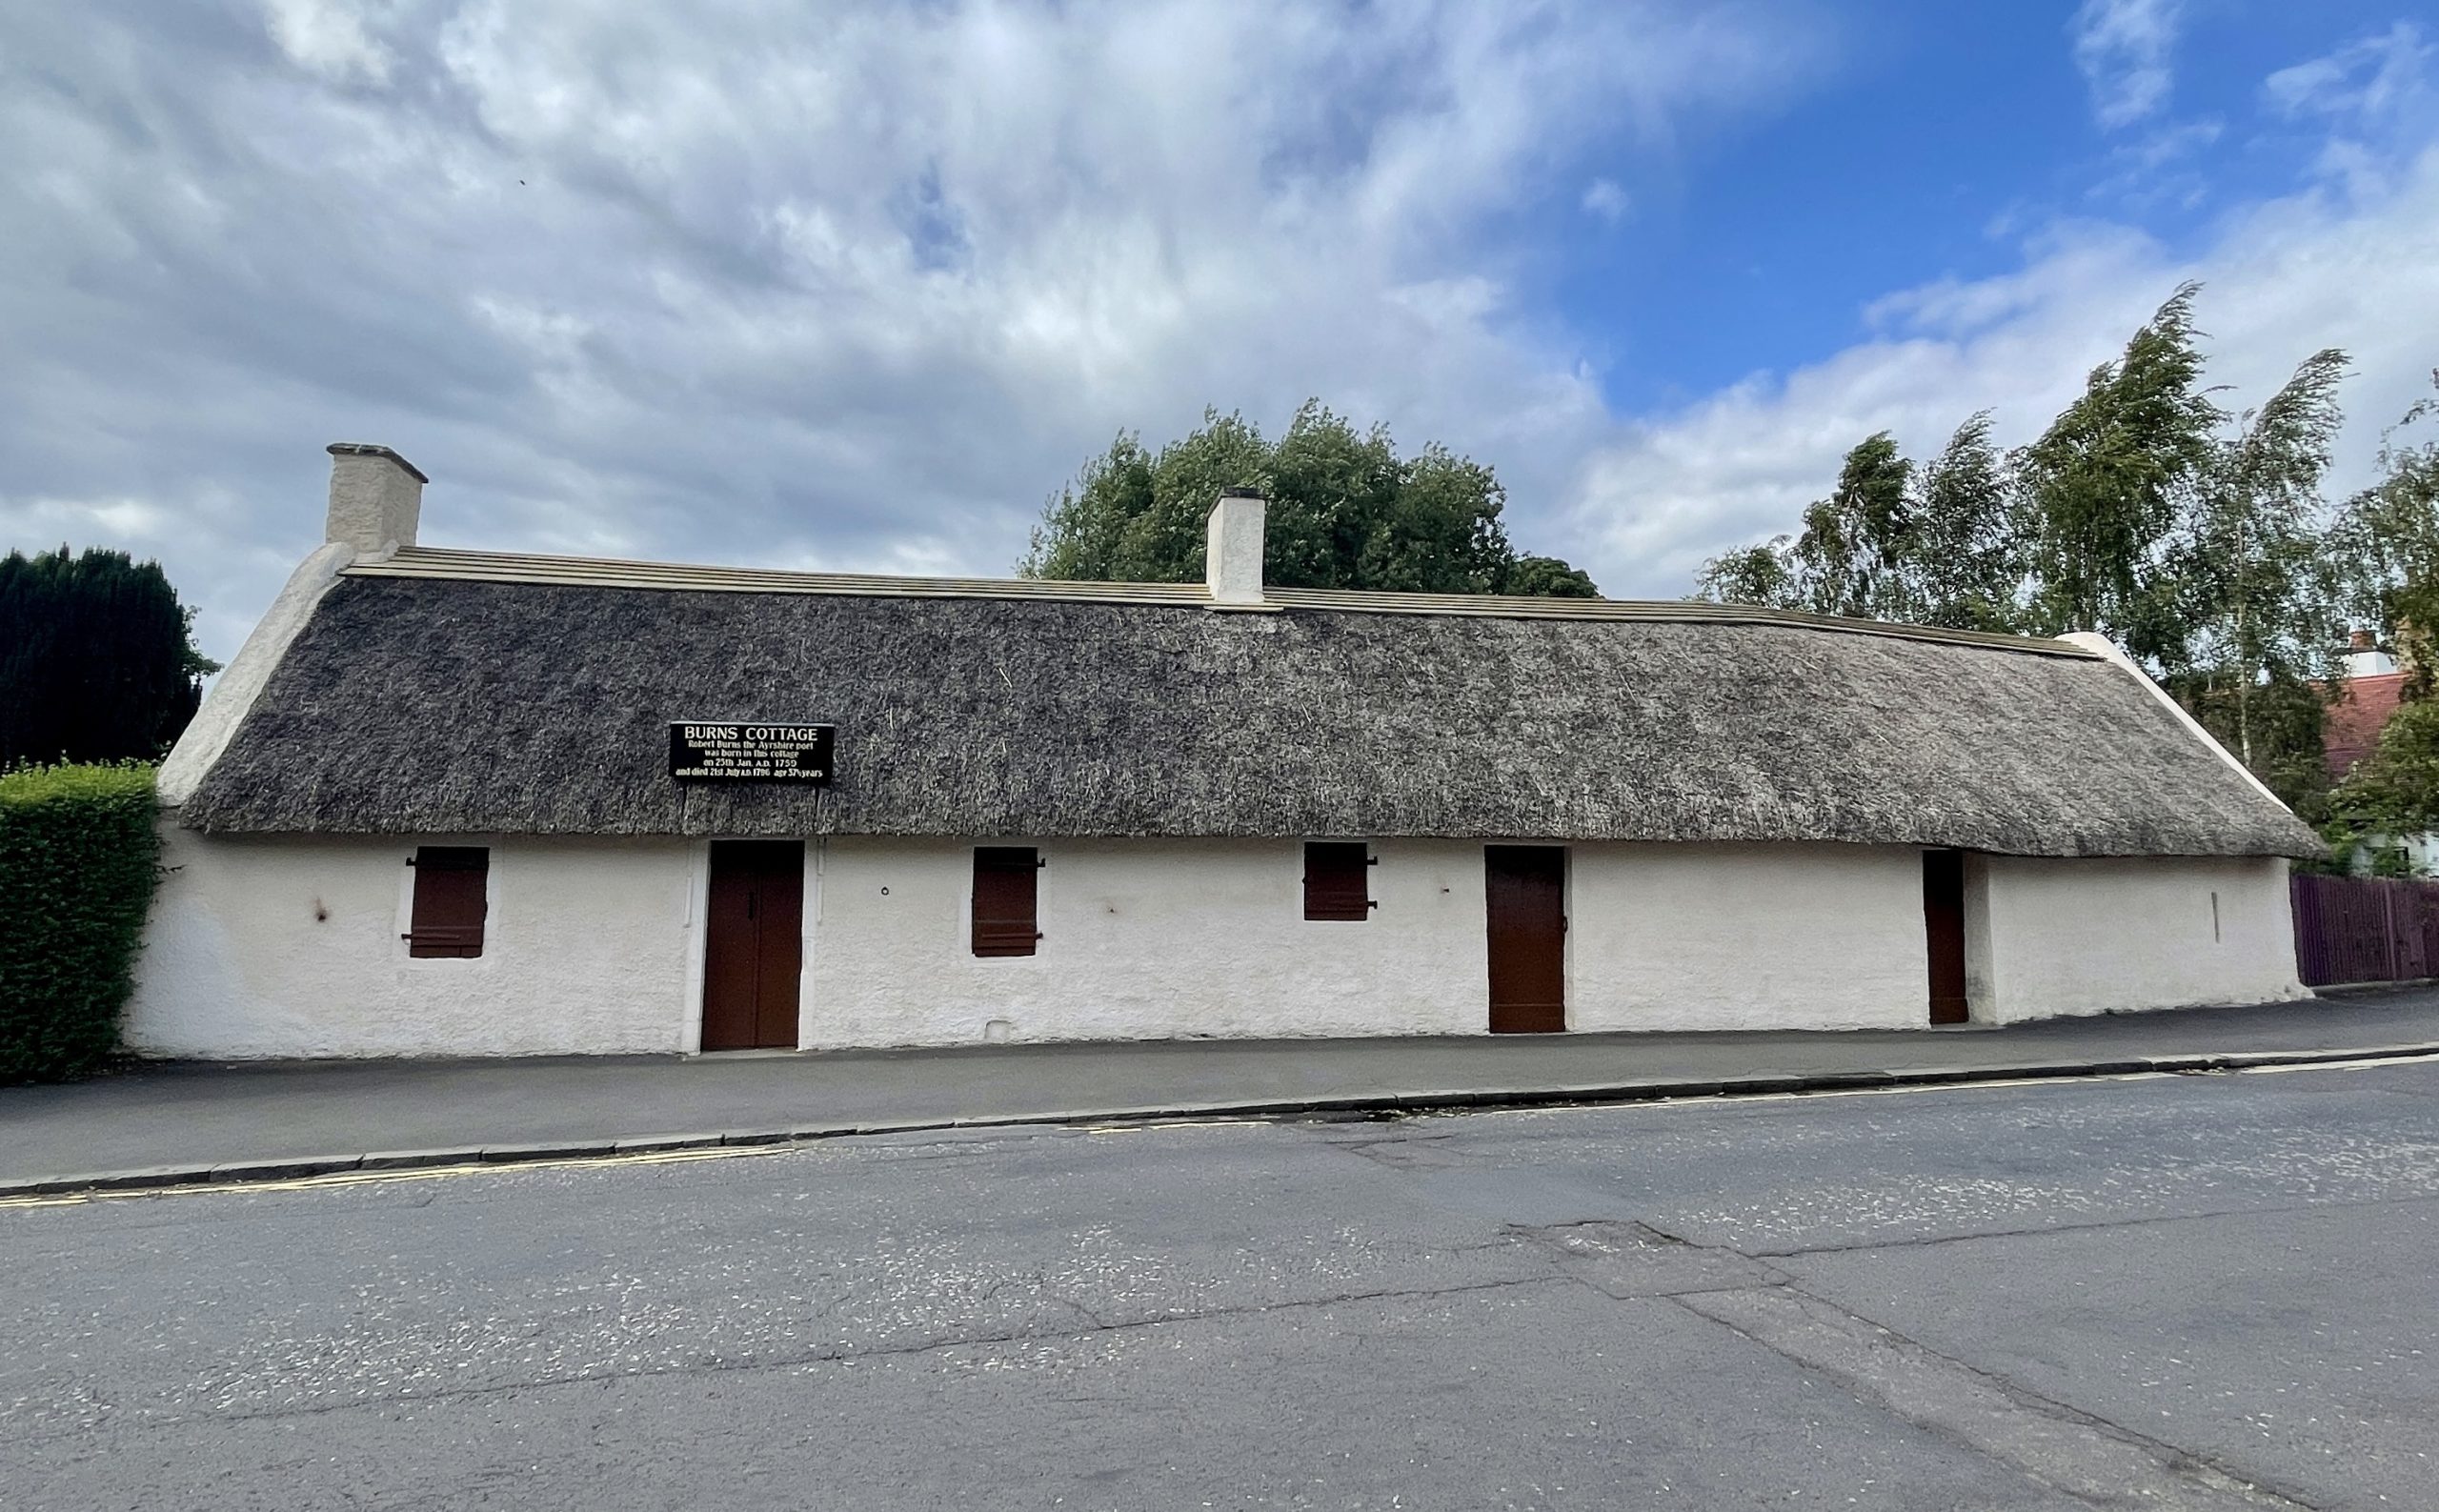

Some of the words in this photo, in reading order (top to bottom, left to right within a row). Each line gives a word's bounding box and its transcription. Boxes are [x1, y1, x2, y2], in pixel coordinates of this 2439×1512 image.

[684, 726, 738, 739] BURNS
[745, 727, 818, 741] COTTAGE
[688, 739, 715, 749] Robert
[716, 740, 741, 749] Burns
[758, 741, 795, 751] Ayrshire
[796, 742, 814, 751] poet
[721, 749, 741, 757] born
[770, 750, 799, 758] cottage
[715, 758, 735, 767] 25th
[775, 759, 797, 768] 1759
[675, 768, 691, 776] and
[692, 767, 708, 776] died
[710, 768, 724, 776] 21st
[725, 768, 740, 777] July
[753, 768, 771, 776] 1796
[801, 769, 823, 777] years
